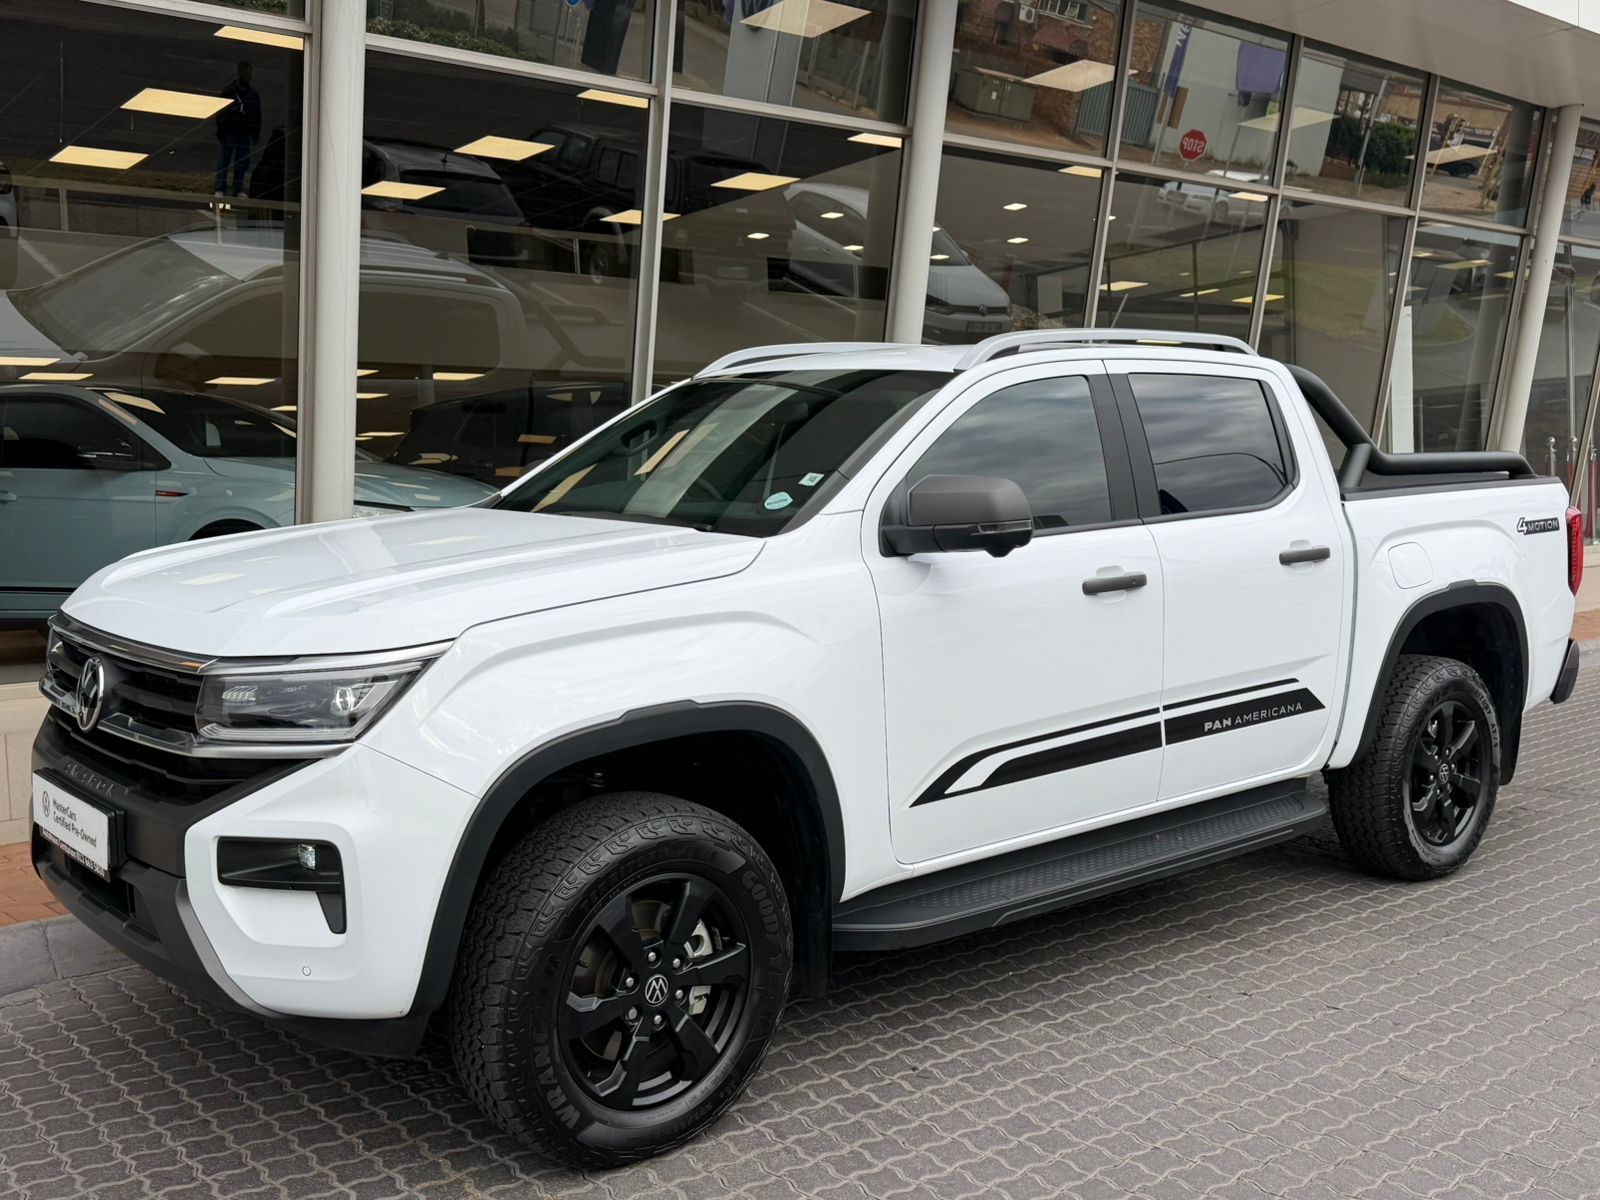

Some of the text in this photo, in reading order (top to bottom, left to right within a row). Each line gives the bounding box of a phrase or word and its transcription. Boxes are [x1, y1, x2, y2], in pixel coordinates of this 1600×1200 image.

[1517, 517, 1560, 534] 4MOTION
[1204, 702, 1303, 732] PAN AMERICANA
[52, 796, 77, 822] MasterCars
[53, 811, 71, 832] Certified
[71, 822, 97, 848] Pre-Owned
